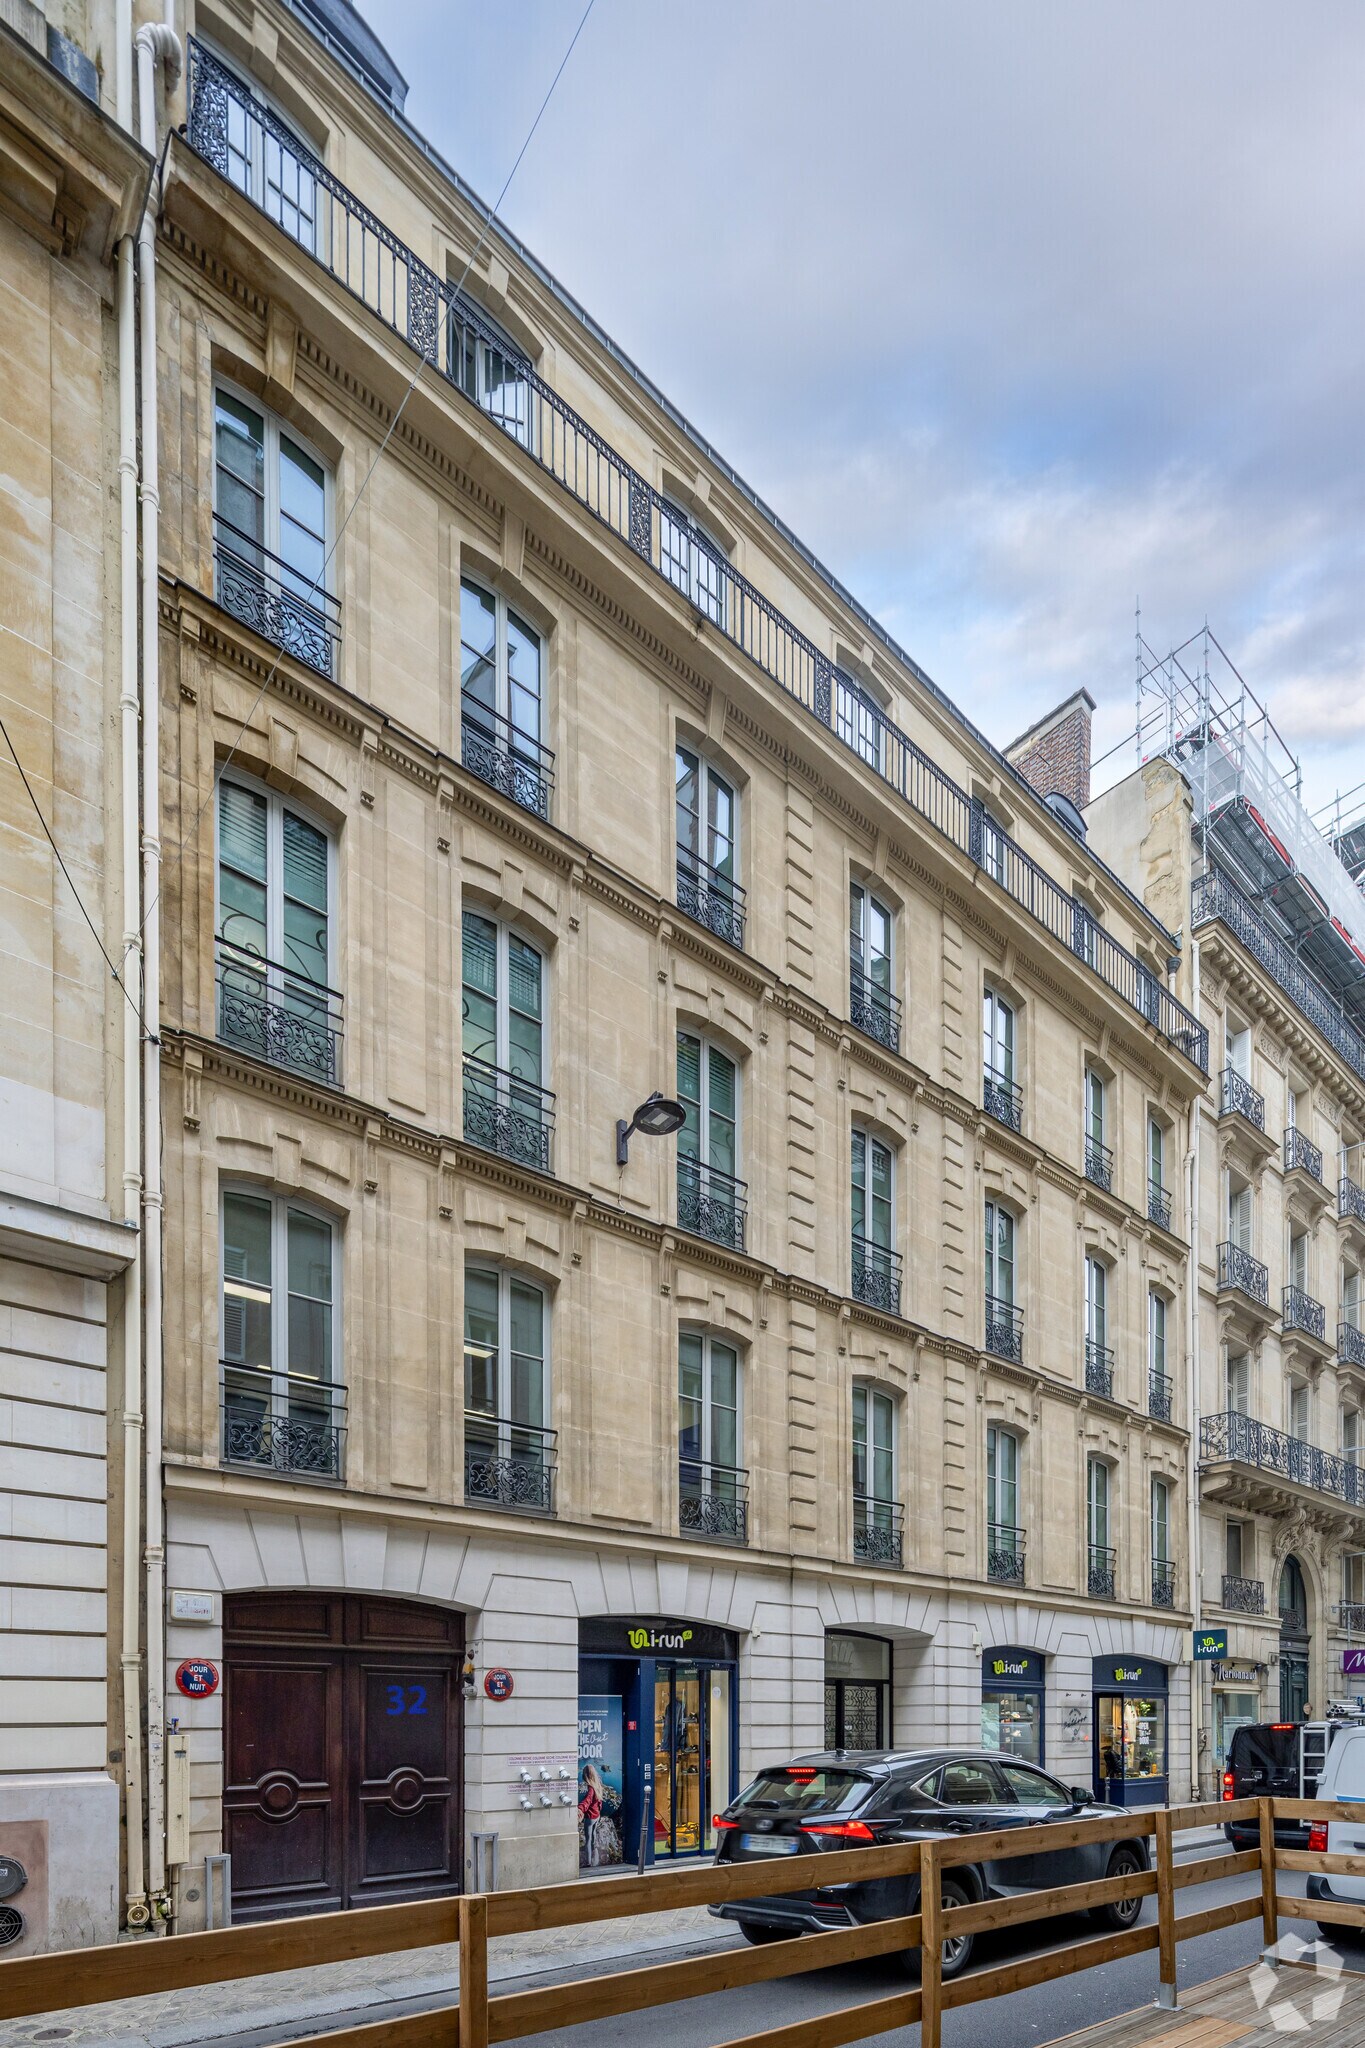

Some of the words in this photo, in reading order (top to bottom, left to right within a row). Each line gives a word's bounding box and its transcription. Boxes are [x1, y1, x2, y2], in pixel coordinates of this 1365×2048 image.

[650, 1629, 684, 1649] i-run
[1197, 1644, 1219, 1654] i-run
[189, 1665, 208, 1673] JOUR
[1004, 1660, 1023, 1674] i-run
[1123, 1668, 1139, 1681] i-run
[189, 1683, 206, 1691] NUIT
[386, 1685, 429, 1716] 32
